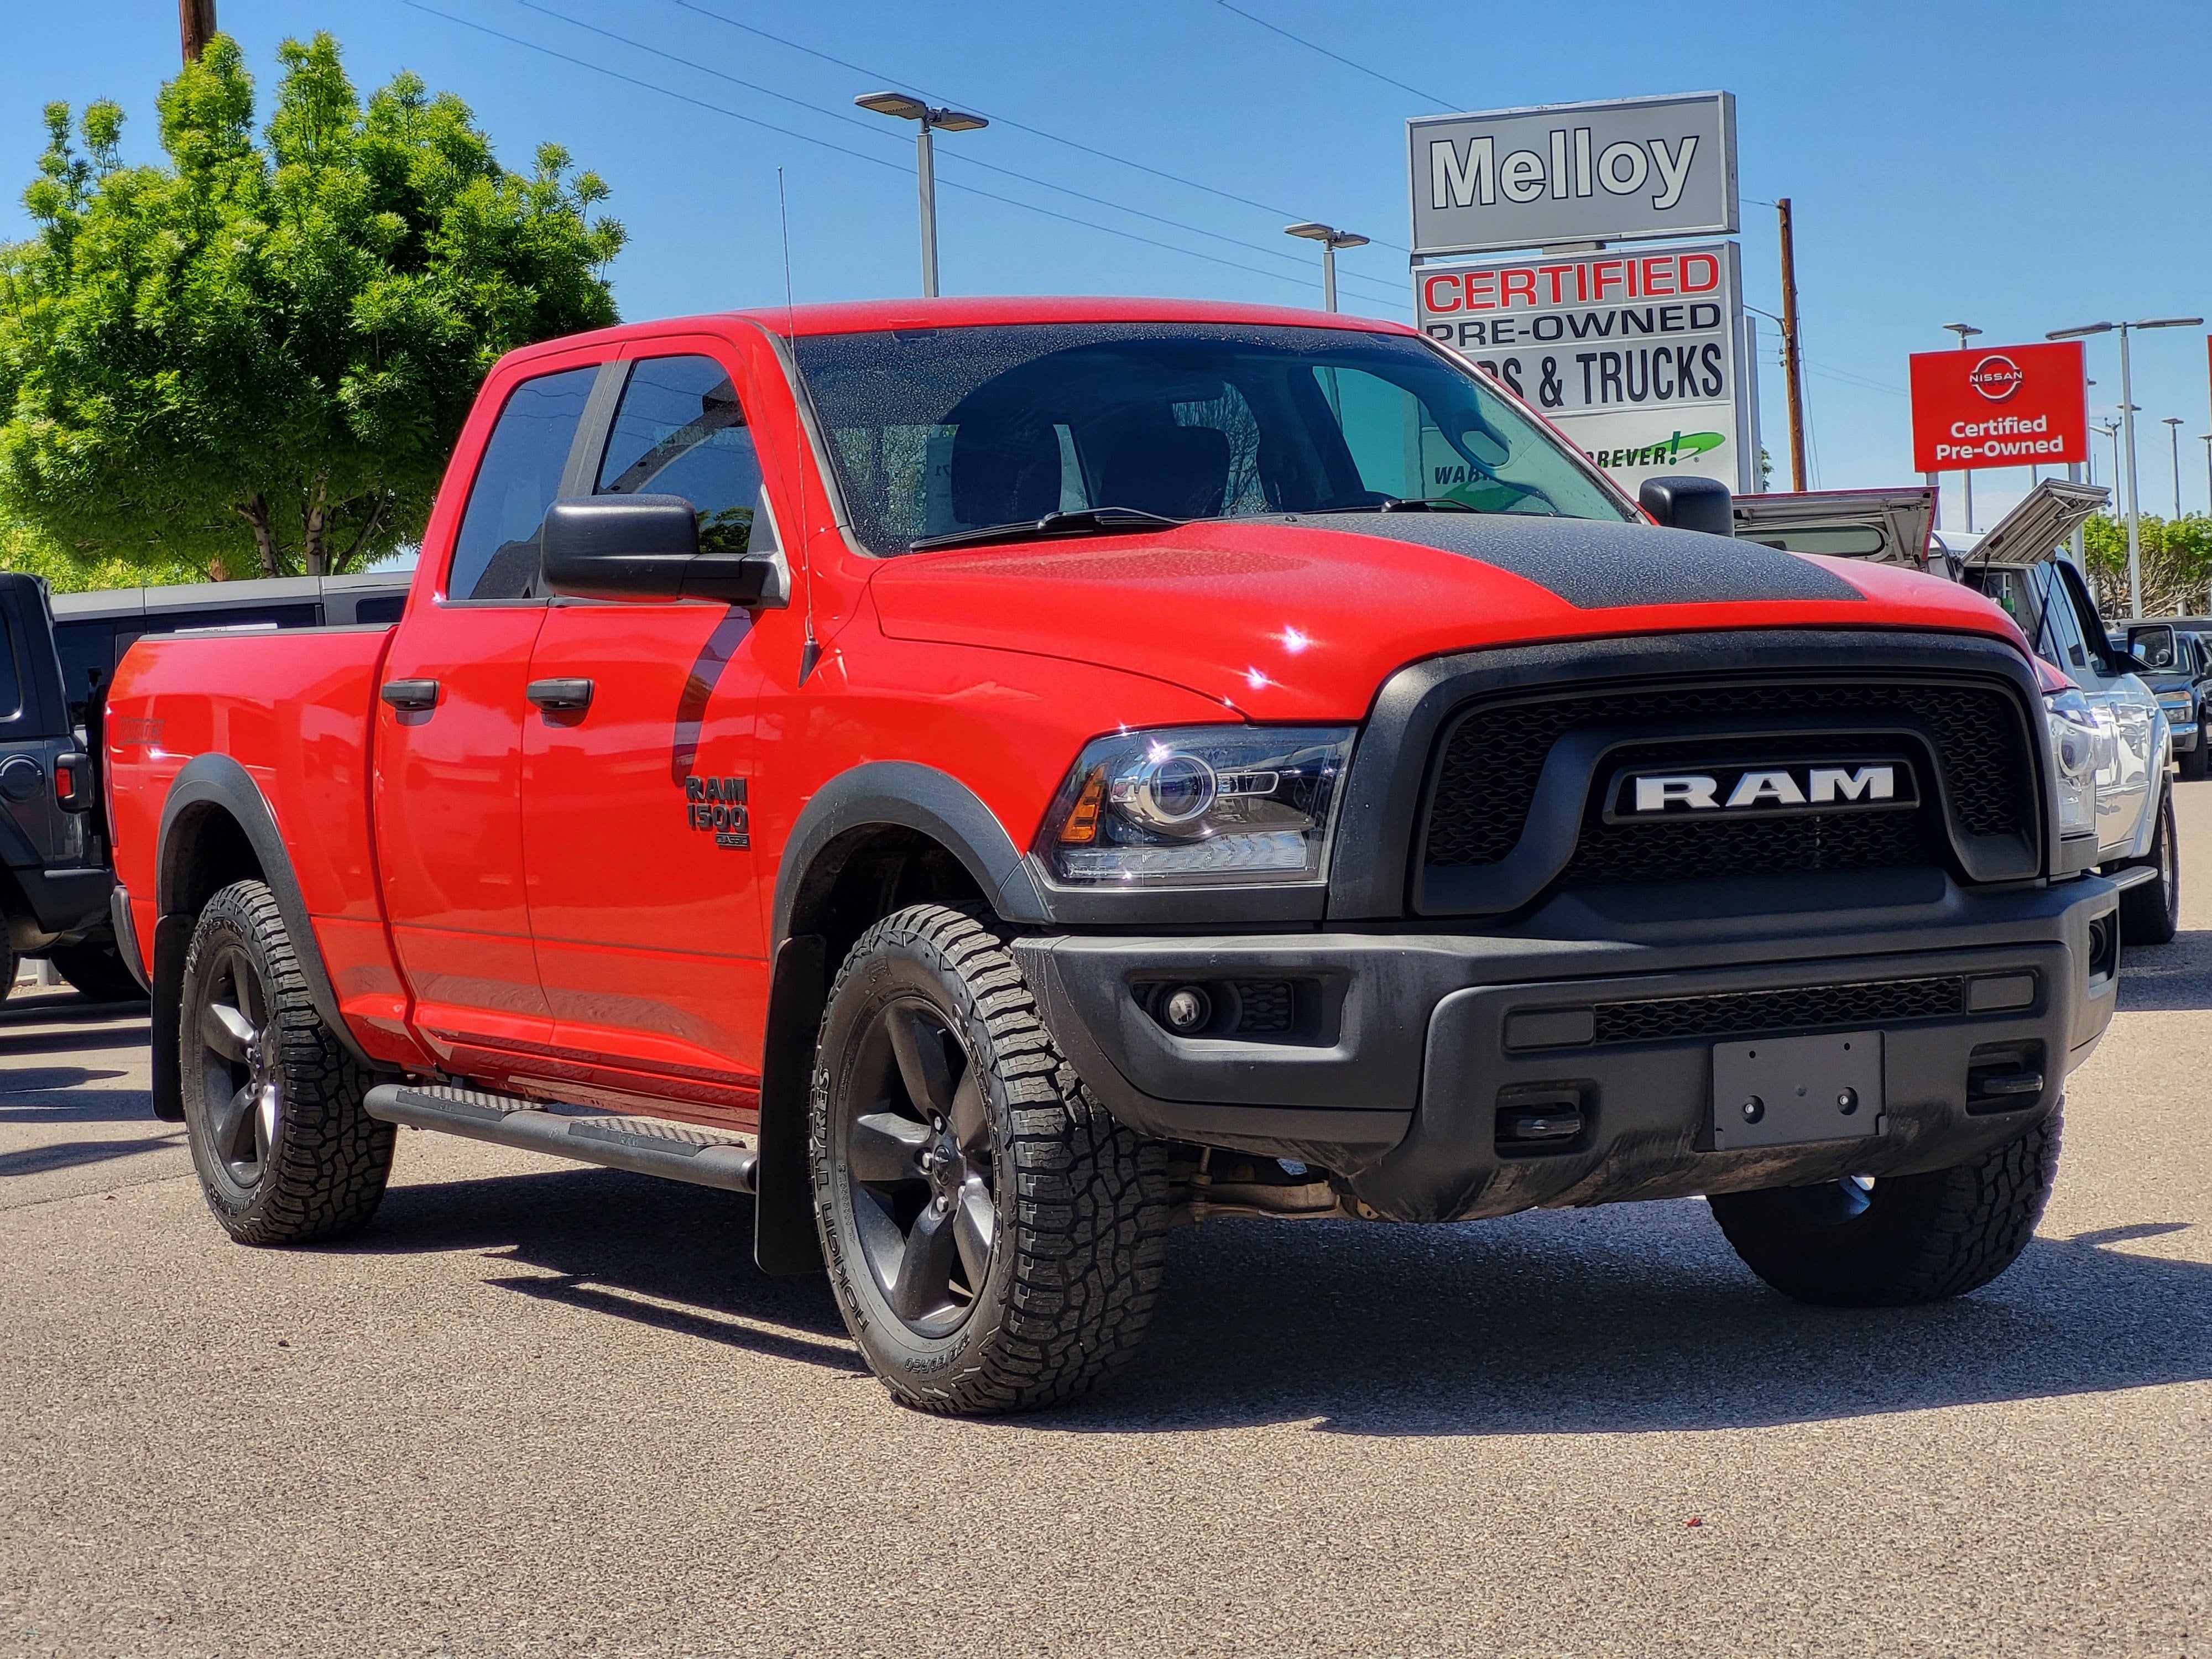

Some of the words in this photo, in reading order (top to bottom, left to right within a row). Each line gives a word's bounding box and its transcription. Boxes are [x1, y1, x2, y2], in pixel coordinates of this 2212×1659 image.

[1430, 127, 1700, 210] Melloy
[1423, 252, 1720, 314] CERTIFIED
[1426, 303, 1721, 347] PRE-OWNED
[1539, 356, 1564, 408] &
[1576, 343, 1723, 405] TRUCKS
[1969, 371, 2023, 383] NISSAN
[1950, 415, 2047, 438] Certified
[1585, 431, 1681, 468] REVER!
[1936, 435, 2064, 460] Pre-Owned
[685, 775, 748, 803] RAM
[1636, 765, 1894, 811] RAM
[687, 803, 748, 832] 1500
[813, 1067, 830, 1191] TYRES
